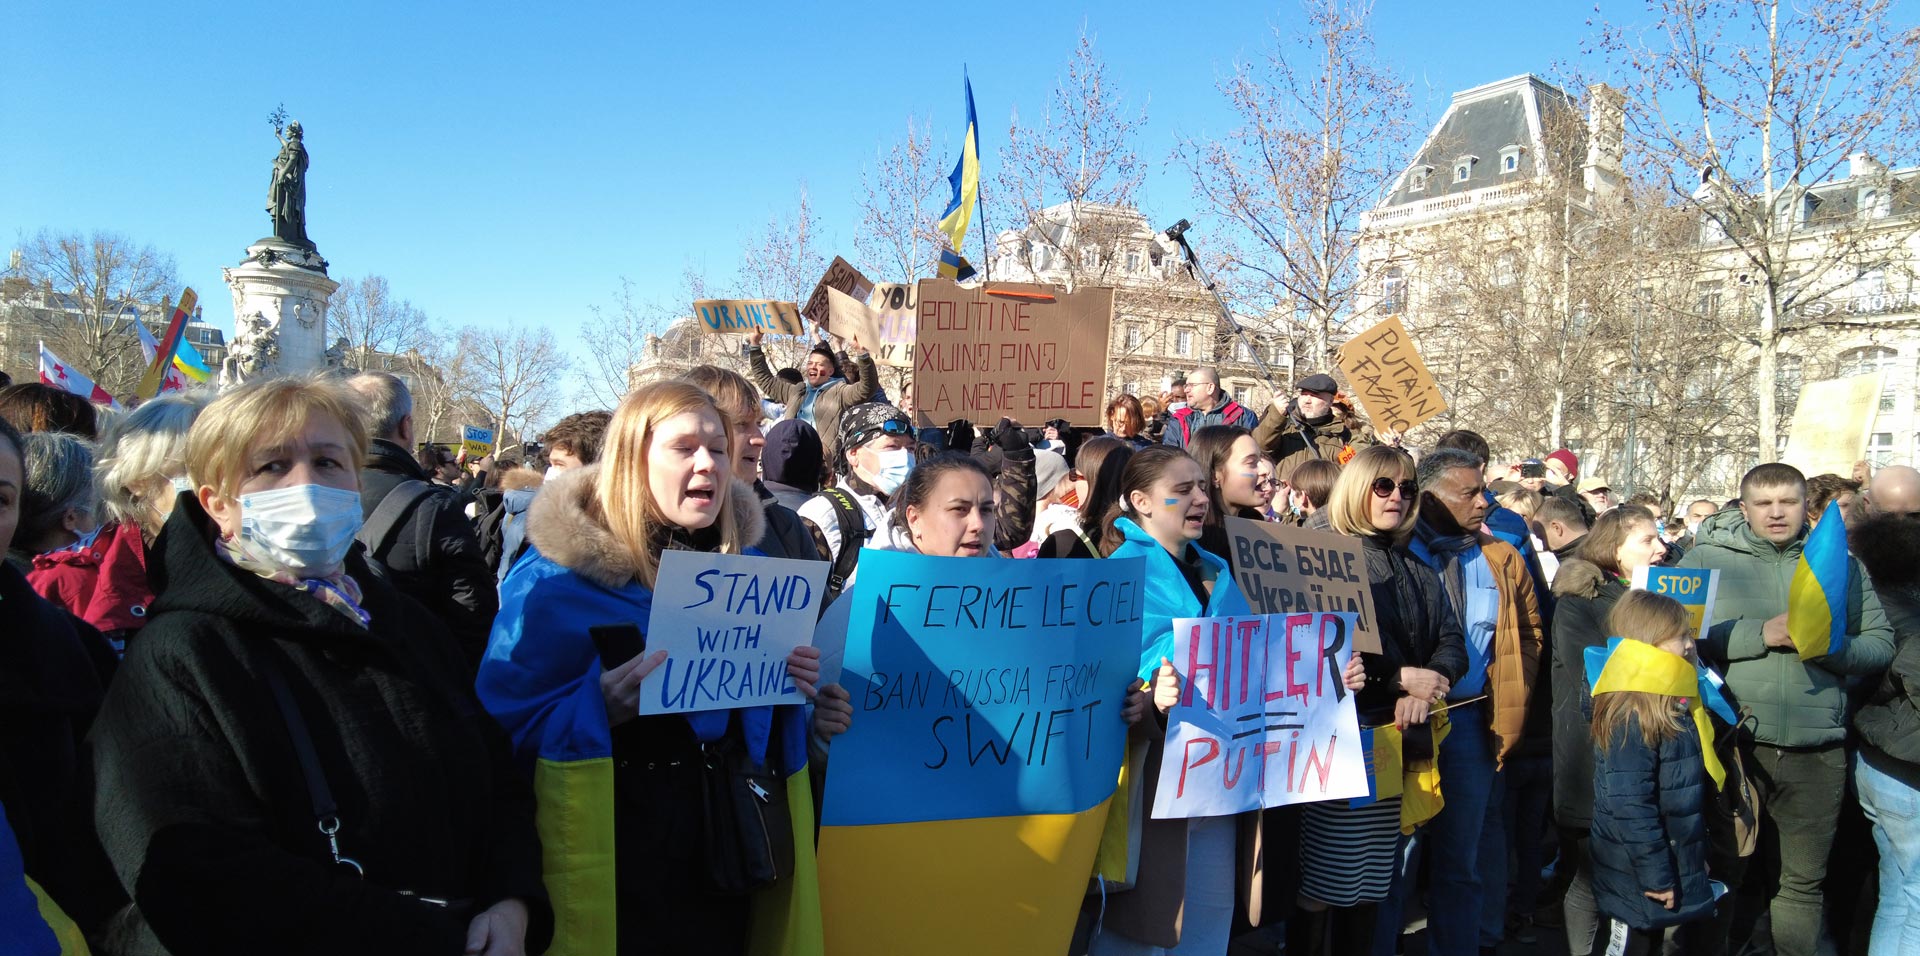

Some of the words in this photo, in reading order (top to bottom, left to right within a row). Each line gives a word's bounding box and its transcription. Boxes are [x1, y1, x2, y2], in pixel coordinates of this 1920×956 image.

[701, 303, 776, 330] URAINE
[917, 383, 953, 412] LA
[962, 382, 1017, 412] MEME
[1028, 381, 1095, 410] ECOLE
[1365, 327, 1437, 418] PUTAIN
[466, 427, 489, 441] STOP
[468, 443, 488, 454] WAR
[1234, 535, 1288, 573] ВСЕ
[1295, 544, 1360, 583] БУДЕ
[683, 569, 811, 615] STAND
[883, 584, 1033, 629] FERME
[1041, 584, 1078, 627] LE
[1086, 580, 1140, 627] CIEL
[1656, 574, 1702, 596] STOP
[697, 624, 762, 654] WITH
[1181, 613, 1347, 710] HITLER
[661, 653, 797, 709] UKRAINE
[863, 671, 932, 712] BAN
[943, 666, 1030, 709] RUSSIA
[1043, 660, 1102, 704] FROM
[923, 700, 1102, 769] SWIFT
[1176, 728, 1338, 799] PUTIN
